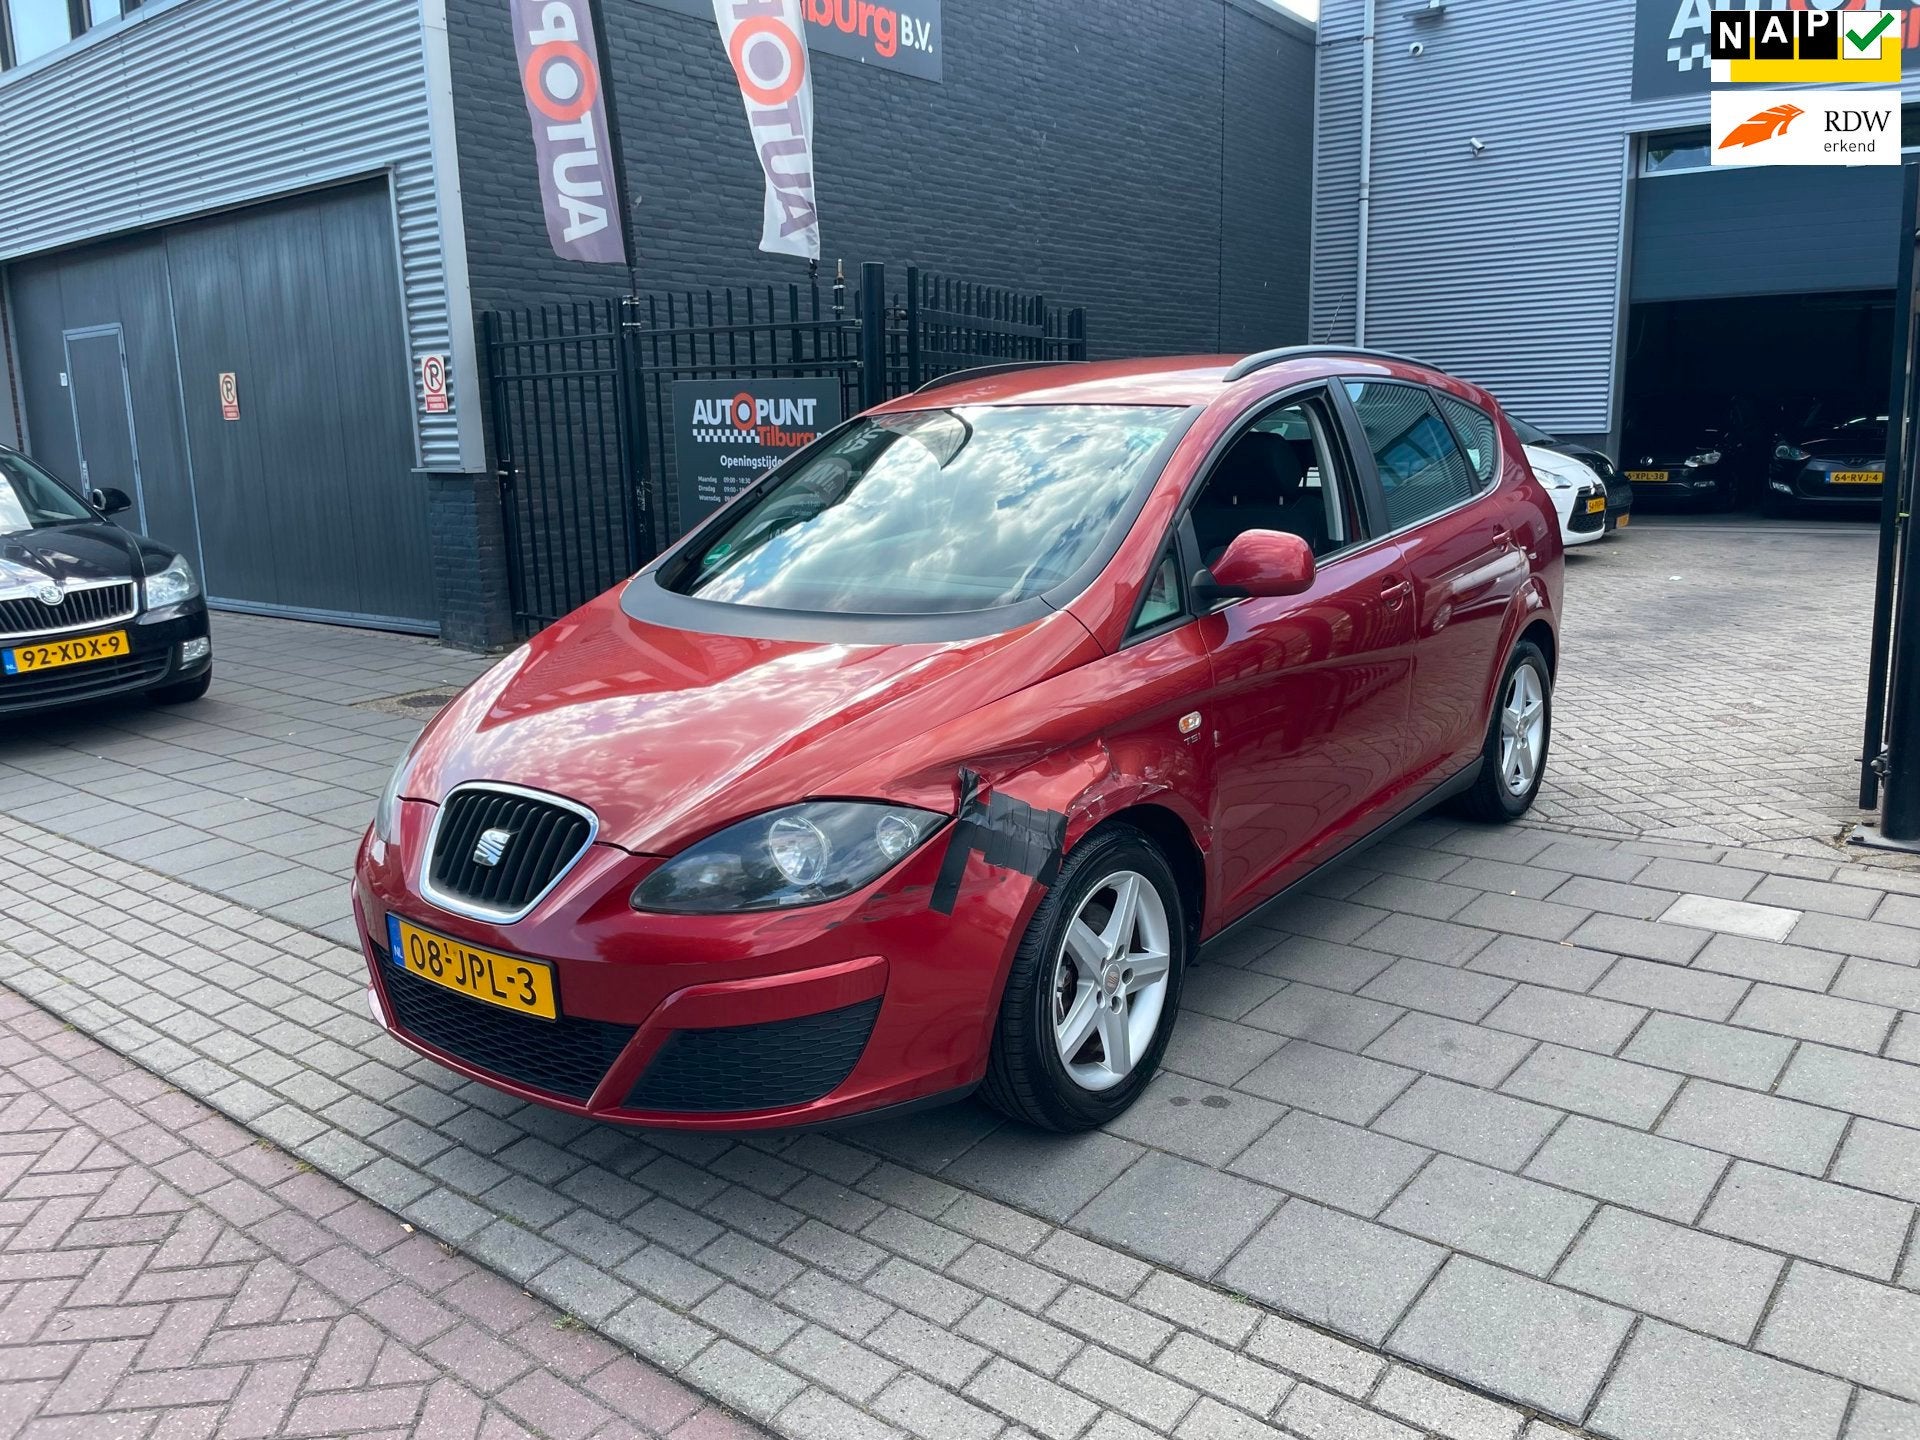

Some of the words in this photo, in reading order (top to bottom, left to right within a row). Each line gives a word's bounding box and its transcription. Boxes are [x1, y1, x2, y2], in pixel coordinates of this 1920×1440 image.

[900, 14, 933, 54] B.V.
[692, 392, 817, 431] AUTOPUNT
[697, 476, 718, 484] Maandag
[1834, 473, 1879, 482] 64-RVJ-4
[22, 636, 120, 668] 92-XDX-9
[410, 933, 537, 1006] 08-JPL-3
